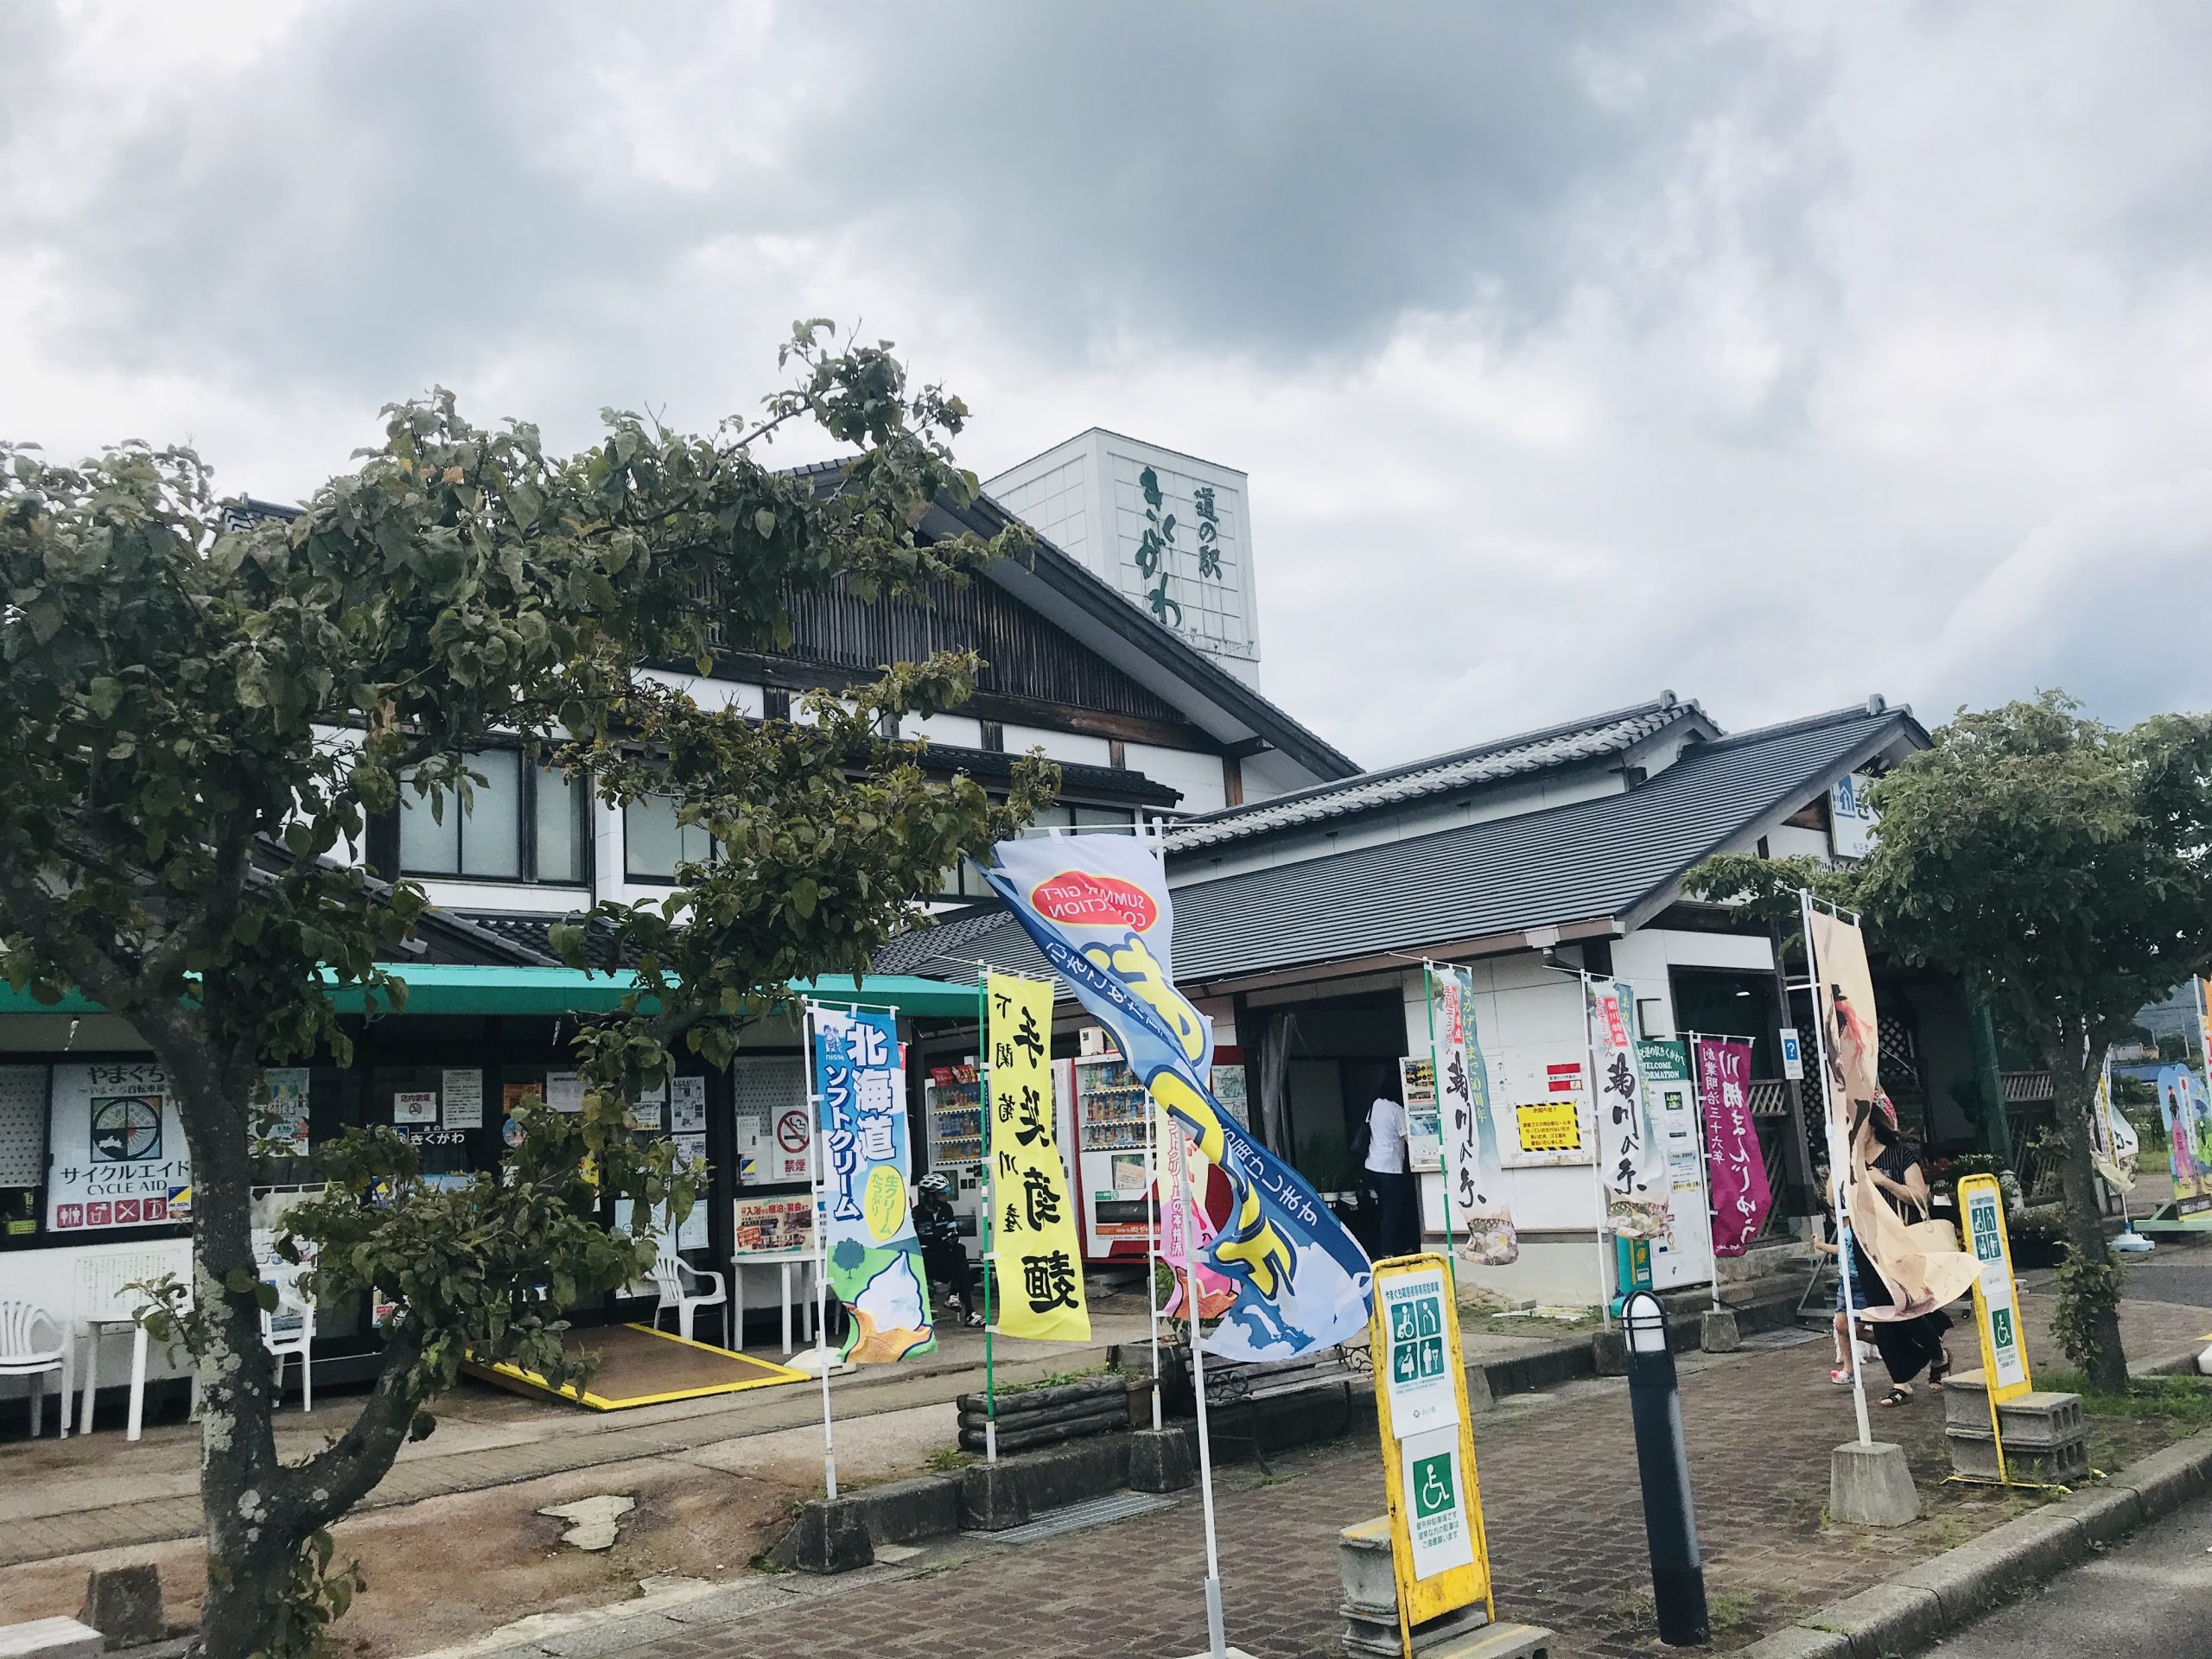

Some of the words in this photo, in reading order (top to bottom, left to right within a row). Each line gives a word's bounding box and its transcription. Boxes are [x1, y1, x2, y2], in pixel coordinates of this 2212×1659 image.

[1135, 466, 1182, 627] きくがわ
[1194, 486, 1223, 581] 道の駅
[87, 1065, 167, 1085] やまぐち
[846, 1020, 897, 1162] 北海道
[410, 1132, 465, 1146] きくがわ
[823, 1065, 864, 1222] ソフトクリーム
[60, 1160, 190, 1185] サイクルエイド
[87, 1183, 134, 1196] CYCLE
[140, 1179, 167, 1192] AID
[785, 1159, 806, 1173] 禁煙
[879, 1174, 899, 1236] 生クリーム
